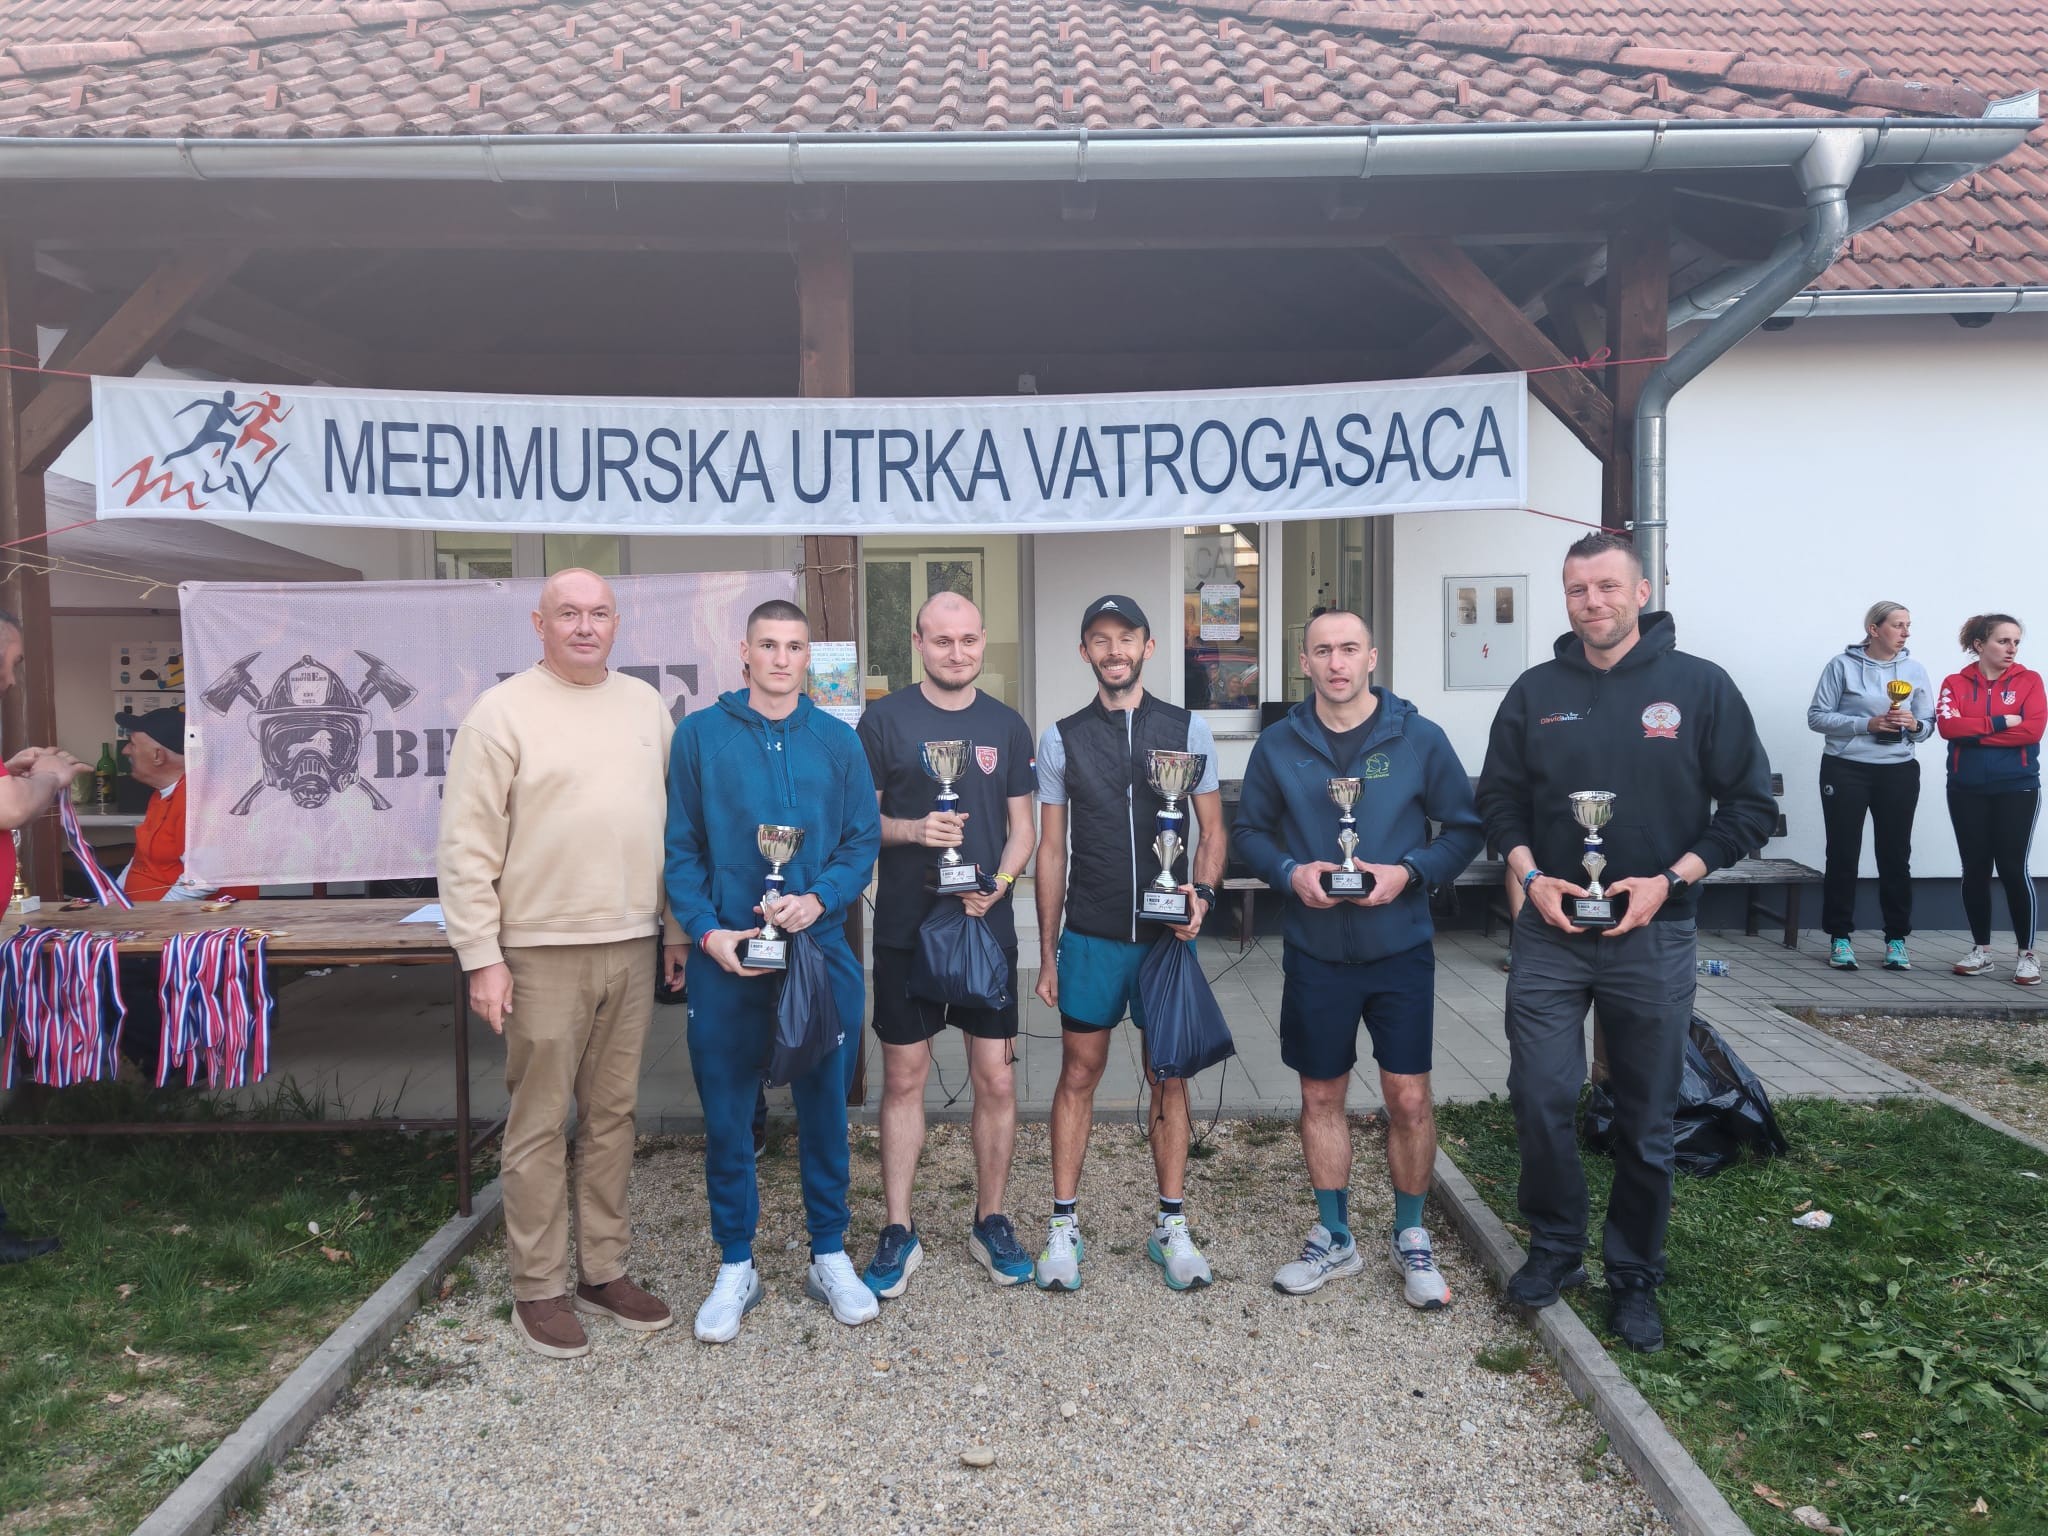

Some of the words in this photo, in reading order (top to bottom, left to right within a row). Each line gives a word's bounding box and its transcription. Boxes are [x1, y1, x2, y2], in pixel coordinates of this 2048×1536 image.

[324, 418, 776, 505] MEĐIMURSKA
[792, 428, 1012, 504] UTRKA
[1022, 405, 1512, 501] VATROGASACA
